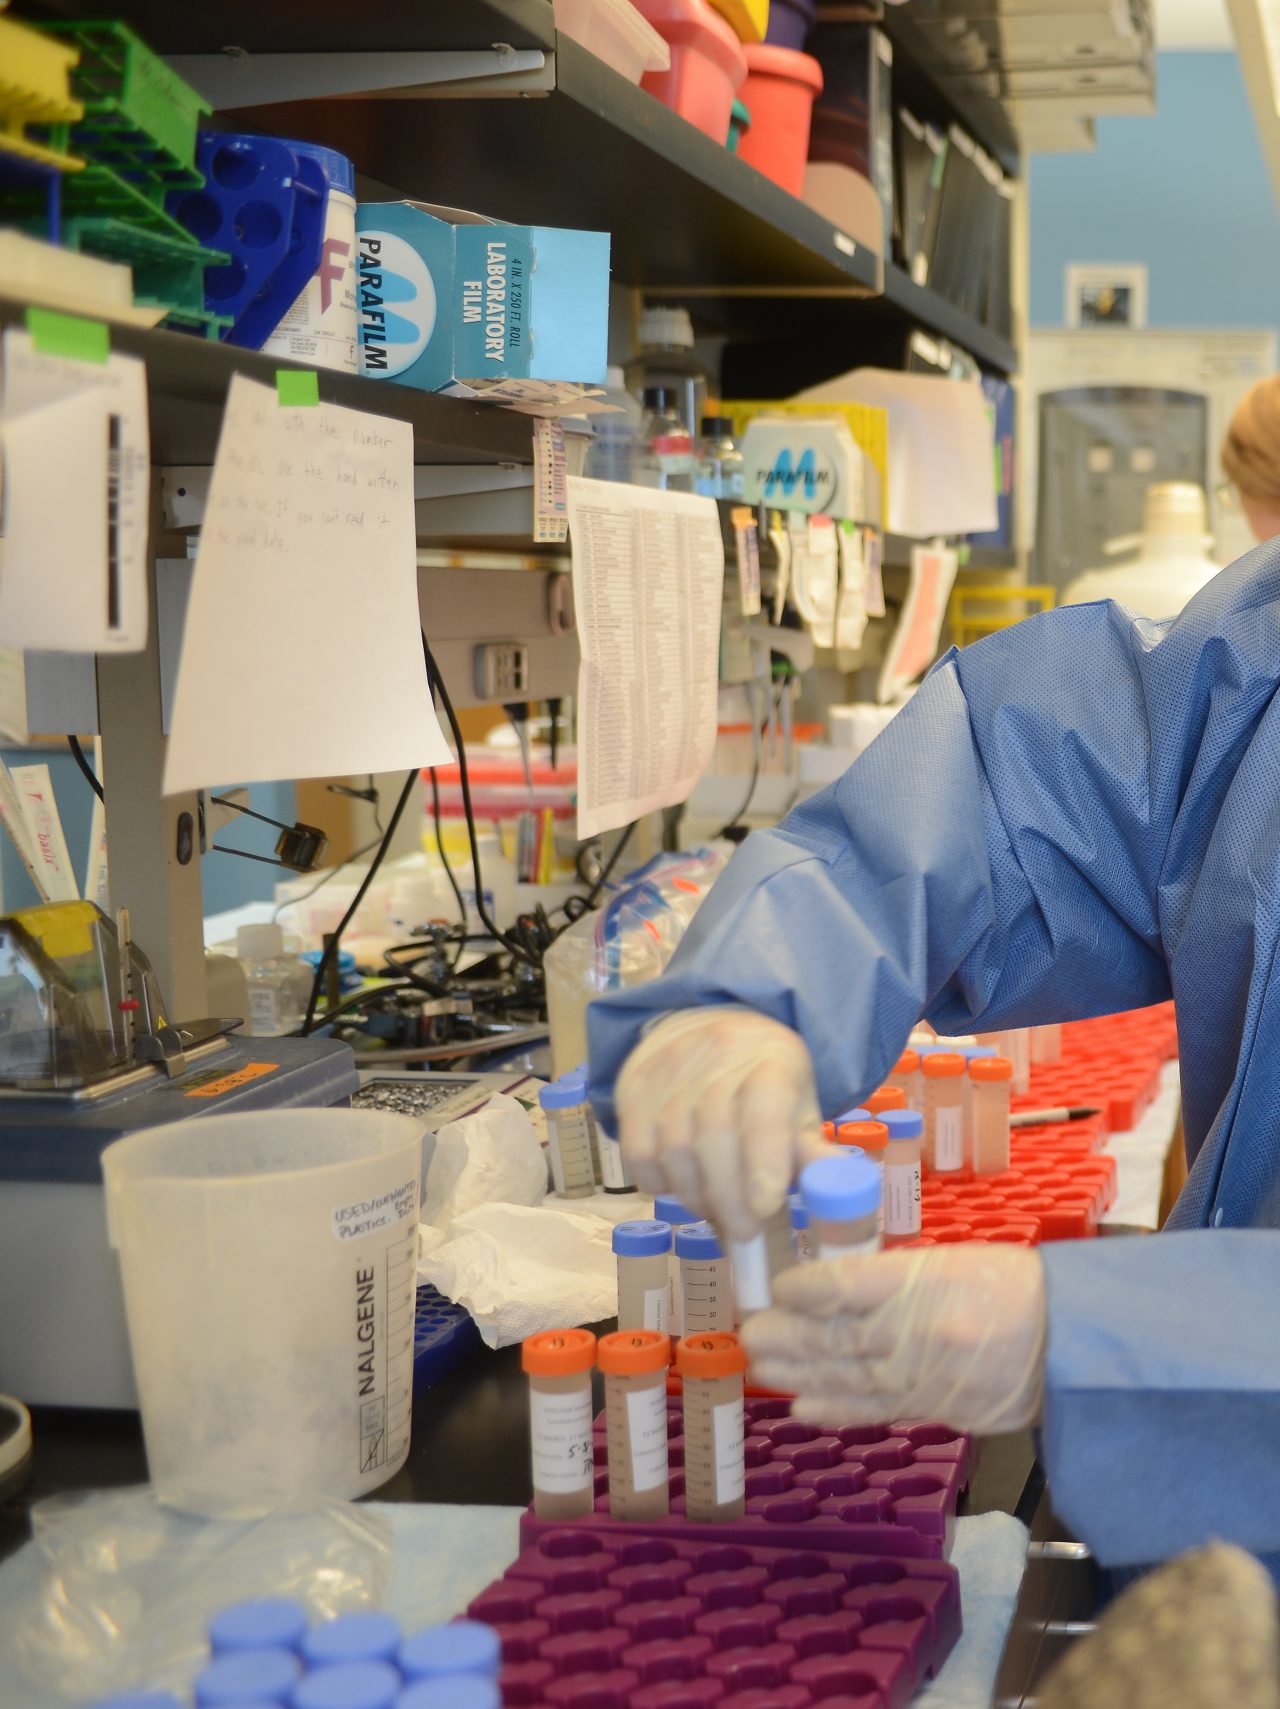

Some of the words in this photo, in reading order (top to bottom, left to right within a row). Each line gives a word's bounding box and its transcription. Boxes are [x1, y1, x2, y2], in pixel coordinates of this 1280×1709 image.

[511, 266, 523, 280] IN.
[360, 237, 388, 369] PARAFILM
[463, 280, 483, 324] FILM
[485, 242, 507, 363] LABORATORY
[510, 289, 522, 312] 250
[509, 312, 522, 323] FT.
[509, 326, 521, 348] ROLL
[756, 469, 830, 486] PARAFILM
[708, 1311, 717, 1319] 30
[356, 1266, 375, 1397] NALGENE
